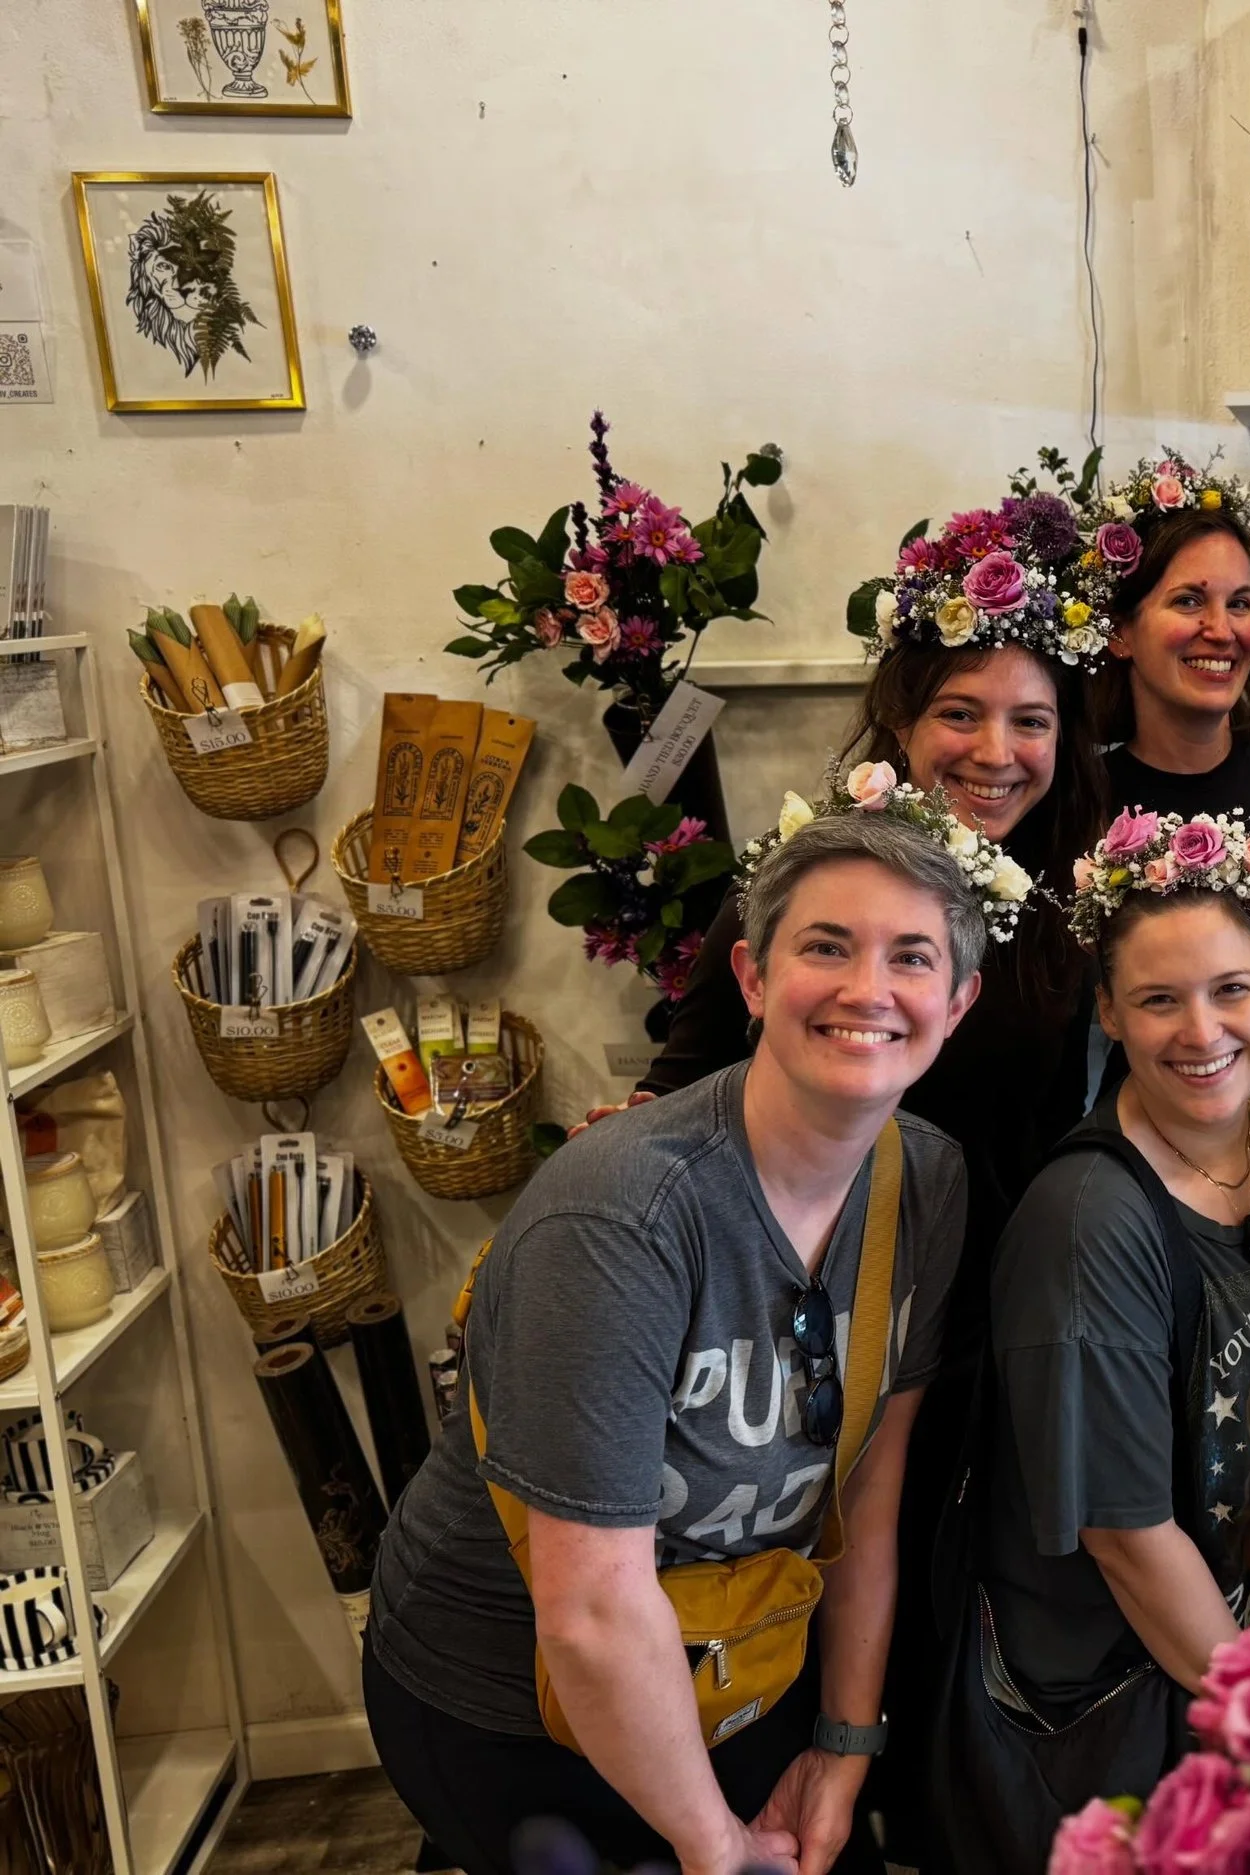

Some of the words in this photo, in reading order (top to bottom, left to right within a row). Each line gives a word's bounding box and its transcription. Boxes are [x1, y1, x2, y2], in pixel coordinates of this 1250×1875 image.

[200, 731, 246, 752] $15.00
[638, 764, 661, 794] HAND
[655, 740, 675, 765] TIED
[671, 697, 704, 742] BOUQUET
[671, 735, 697, 767] $30.00
[376, 903, 417, 918] $5.00
[226, 1025, 275, 1036] $10.00
[425, 1128, 464, 1147] $5.00
[268, 1281, 315, 1301] $10.00
